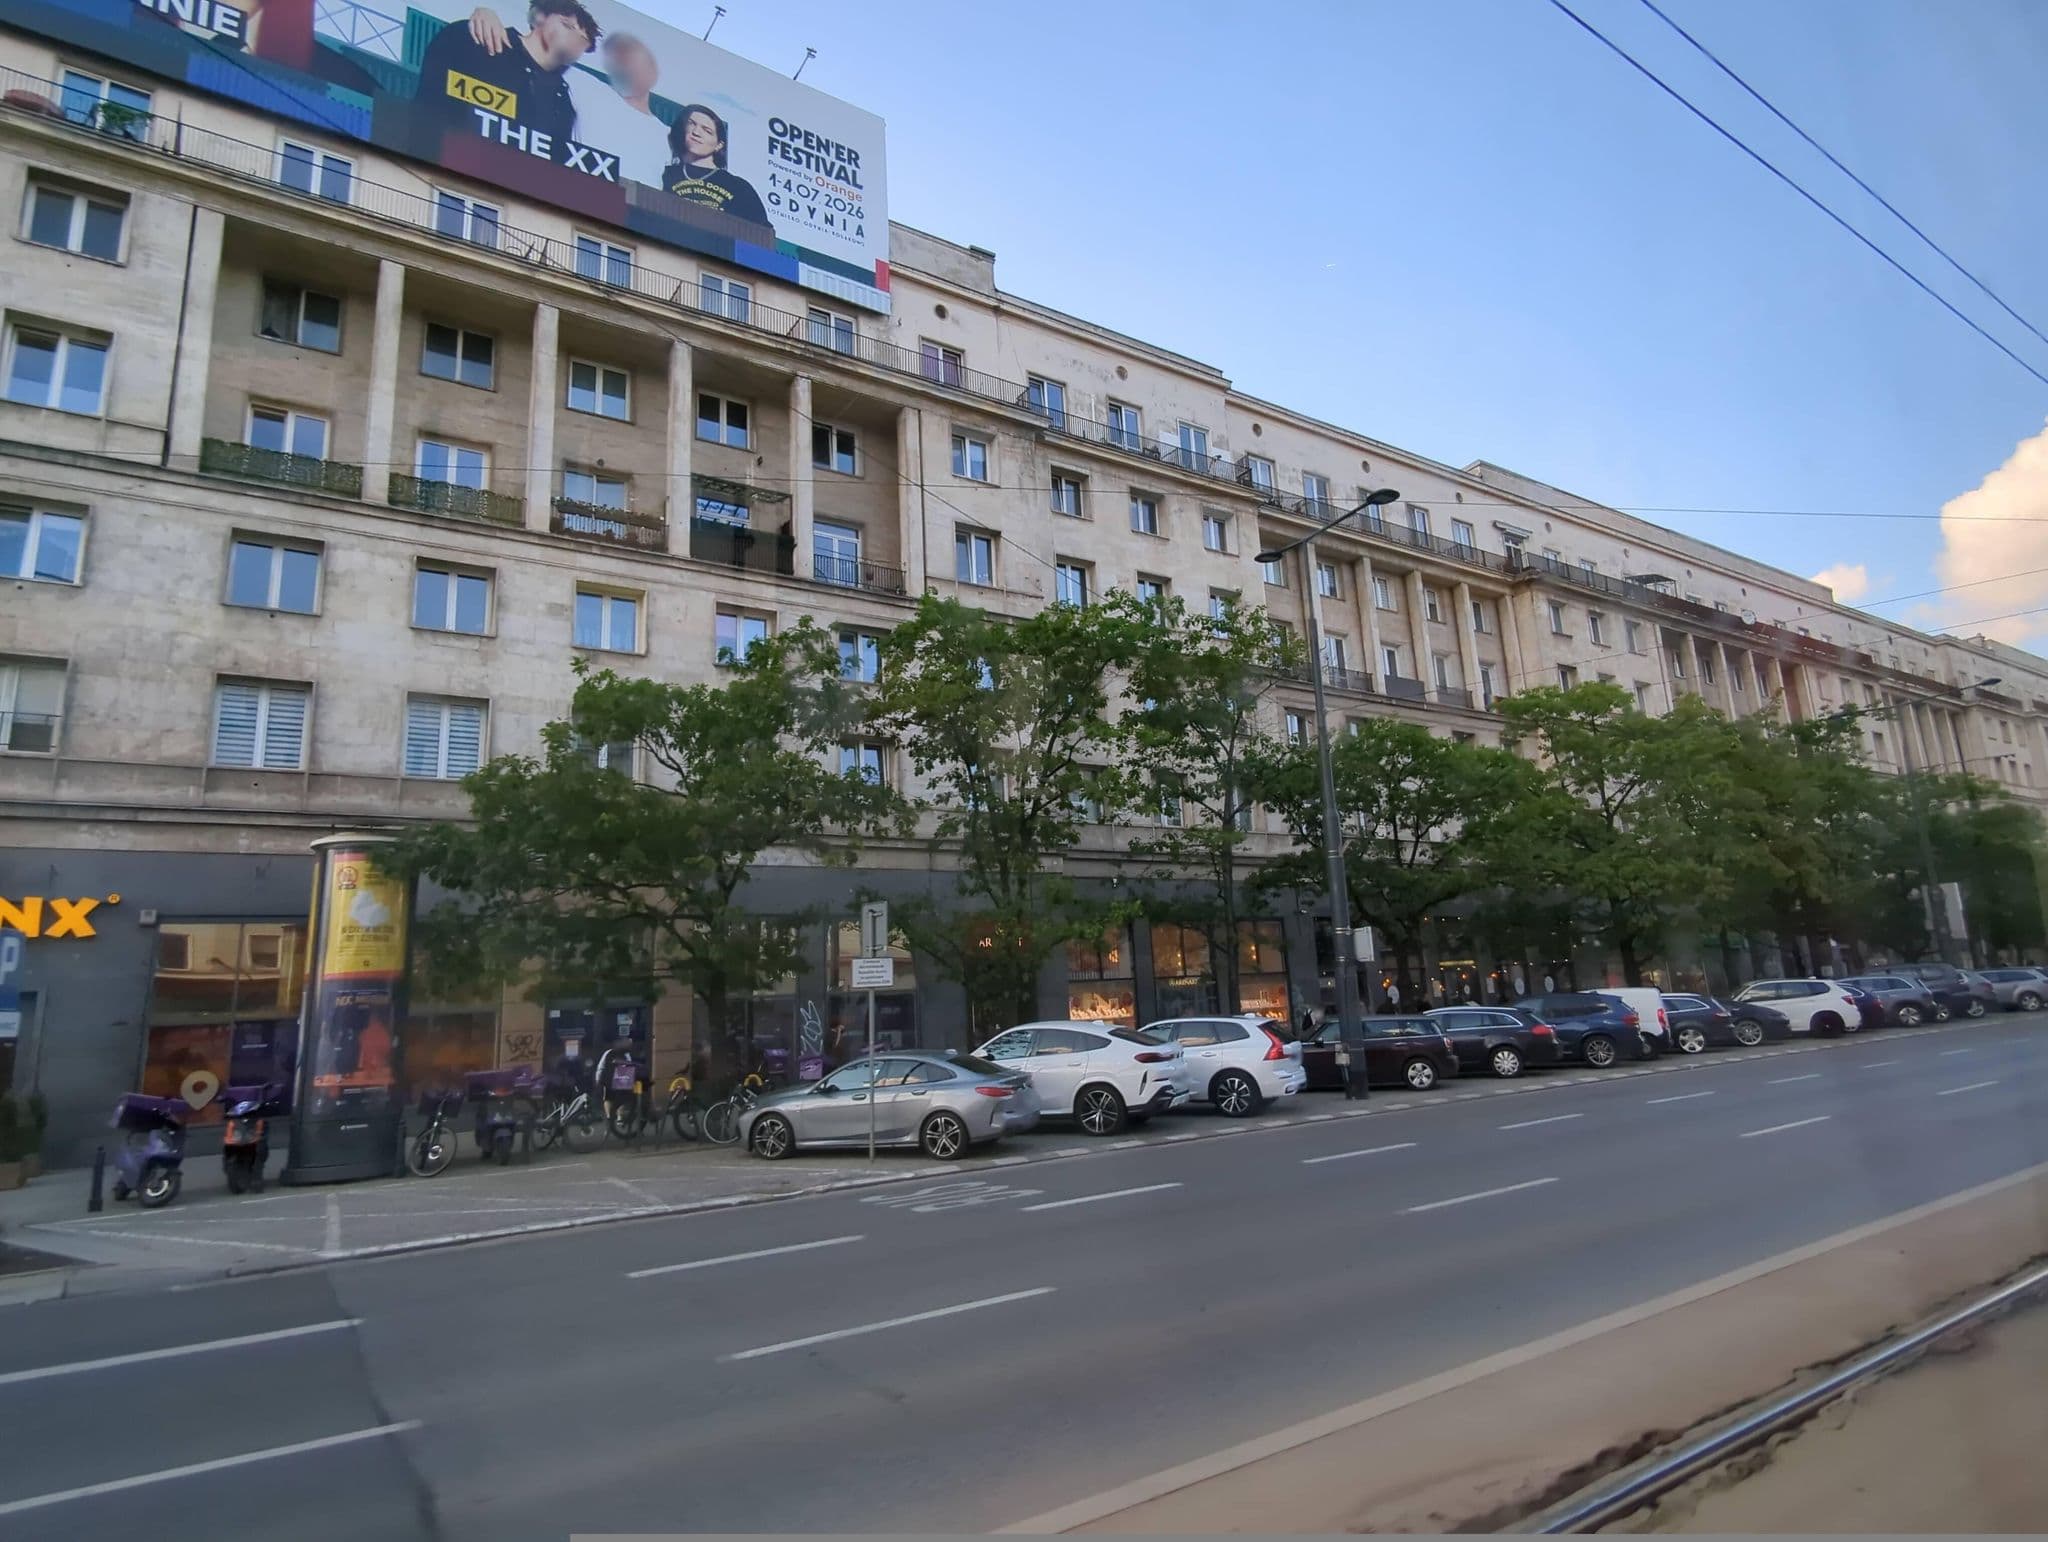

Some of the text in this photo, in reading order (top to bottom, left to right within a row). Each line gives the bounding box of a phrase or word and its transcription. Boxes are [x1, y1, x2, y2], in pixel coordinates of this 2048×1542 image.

[140, 0, 241, 39] NIE
[454, 78, 511, 111] 1.07
[474, 108, 615, 183] THE XX
[768, 117, 861, 170] OPEN'ER
[768, 135, 864, 190] FESTIVAL
[676, 188, 693, 197] THE
[768, 159, 863, 203] Powered by Orange
[767, 191, 865, 239] GDYNIA
